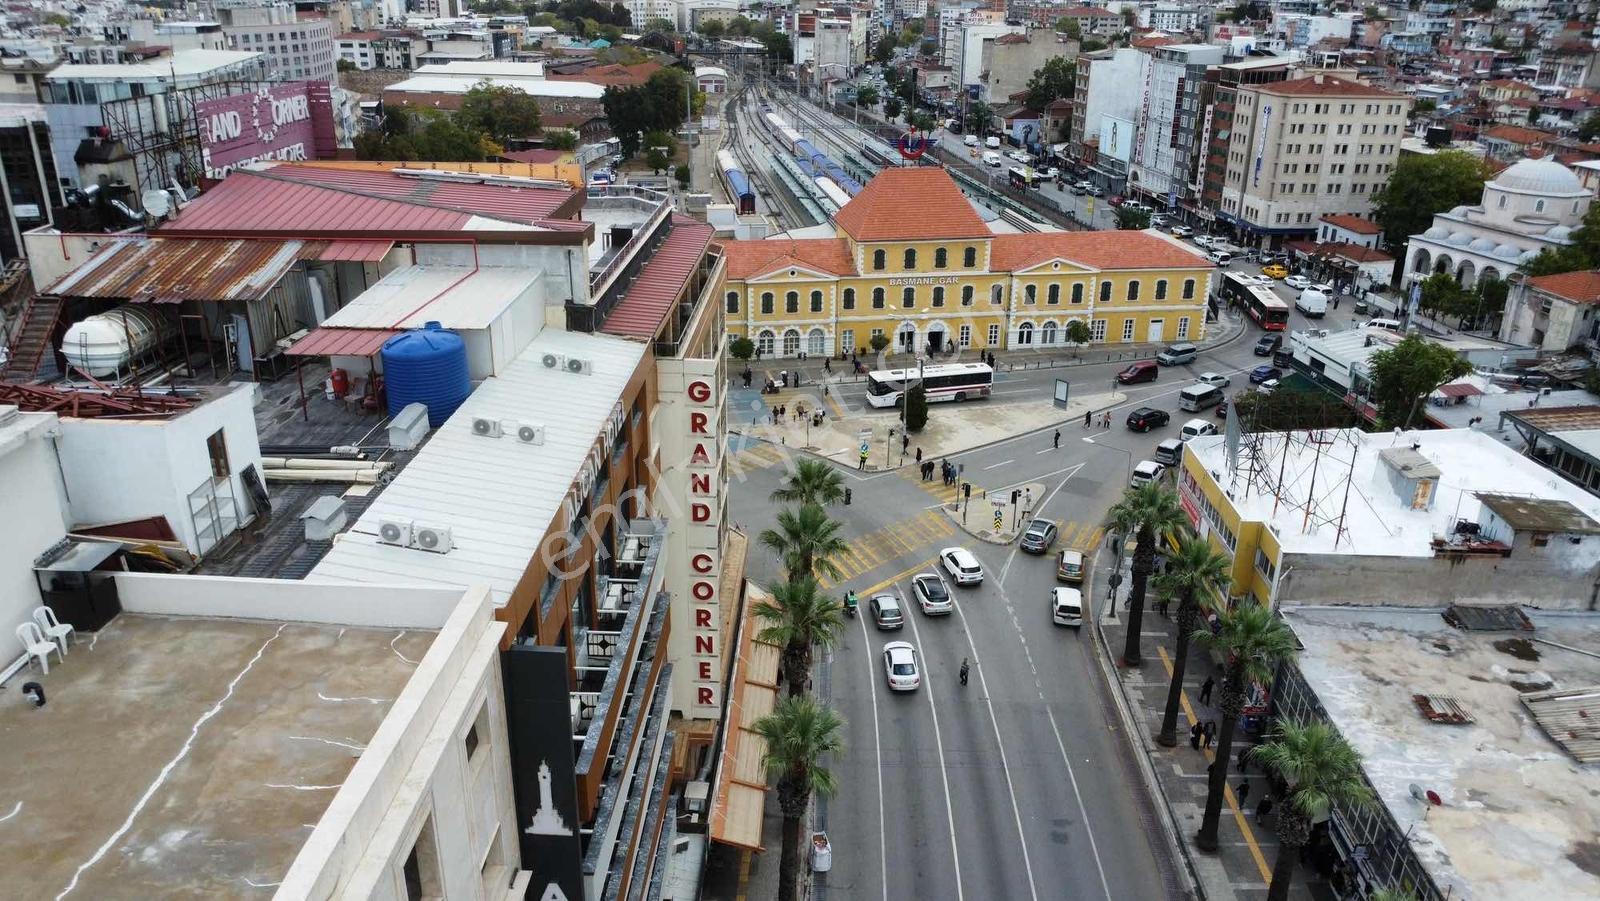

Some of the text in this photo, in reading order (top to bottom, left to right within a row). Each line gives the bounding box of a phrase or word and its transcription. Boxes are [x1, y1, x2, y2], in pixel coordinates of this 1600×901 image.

[1141, 90, 1150, 128] CORNER
[205, 111, 241, 143] AND
[889, 277, 936, 286] BASMANE
[687, 381, 714, 705] GRAND CORNER
